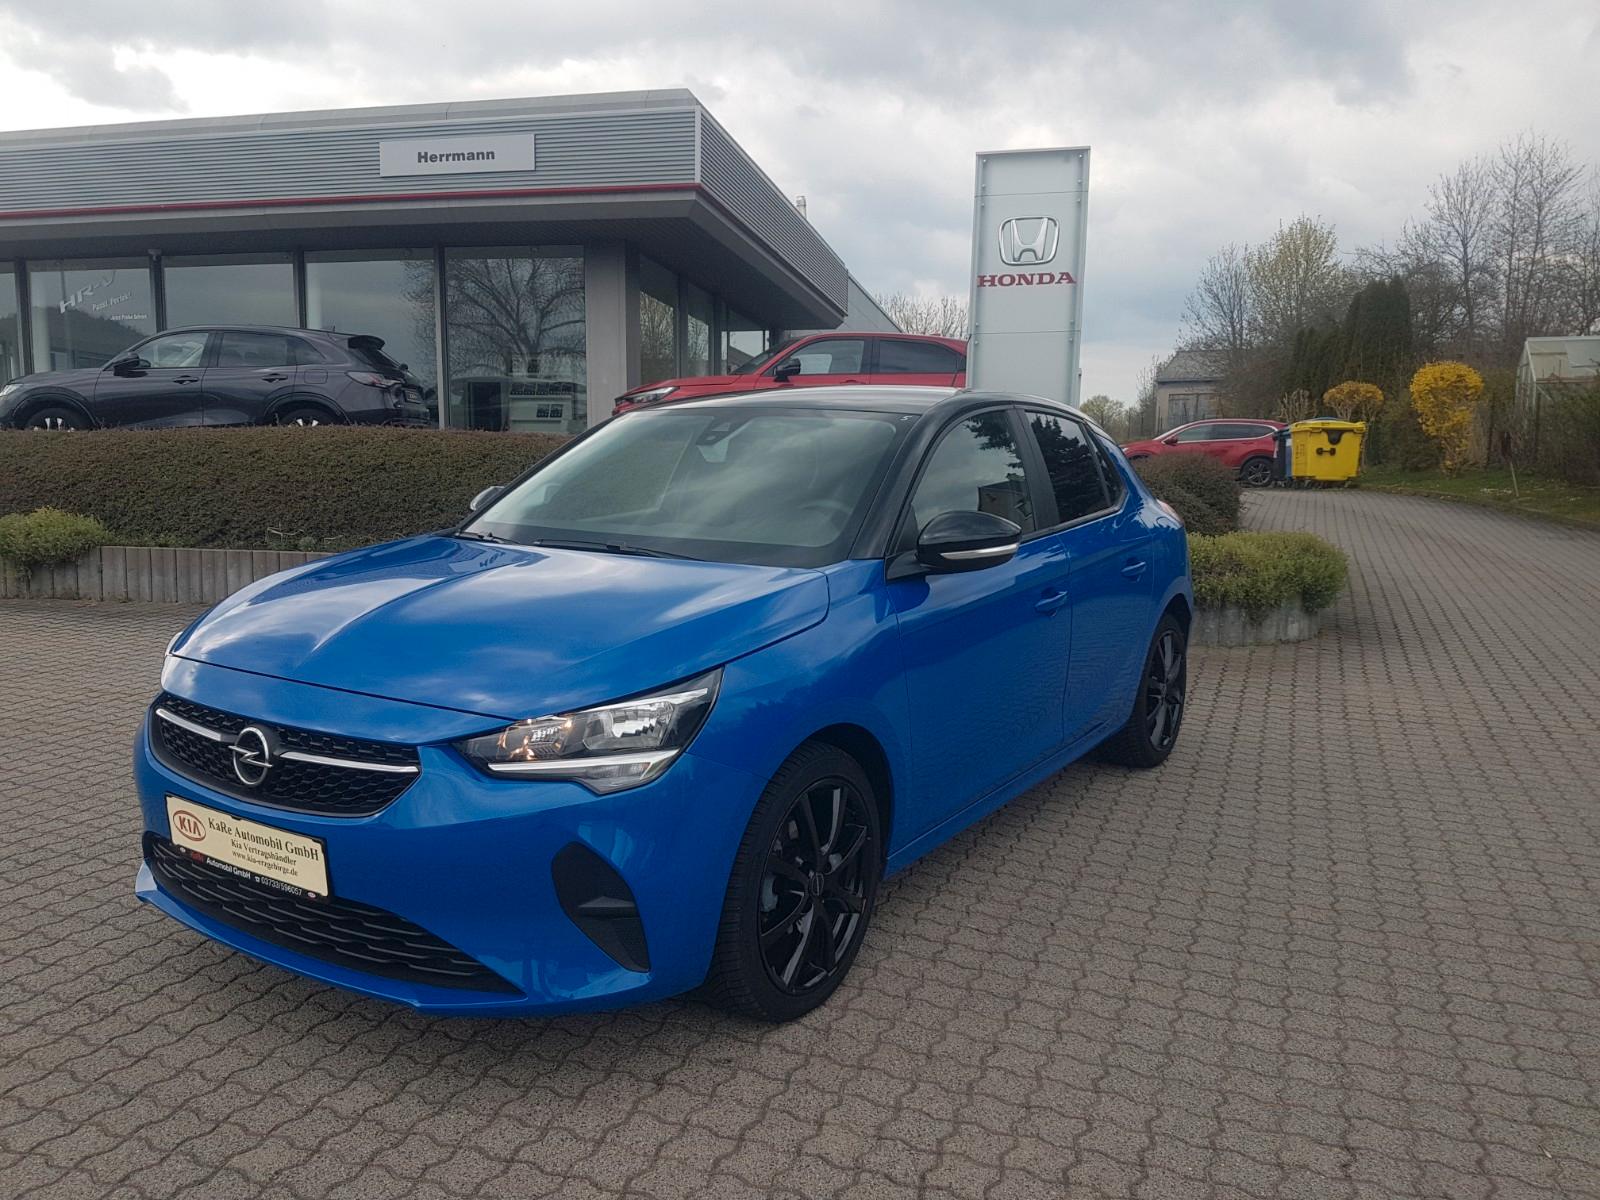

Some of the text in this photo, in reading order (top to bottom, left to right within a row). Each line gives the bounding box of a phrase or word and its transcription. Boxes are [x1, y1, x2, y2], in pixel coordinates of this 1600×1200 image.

[417, 150, 496, 163] Herrmann
[976, 272, 1077, 288] HONDA
[178, 815, 202, 838] KIA
[208, 817, 319, 861] KaRe Automobil GmbH
[231, 838, 242, 849] Kia
[206, 857, 233, 872] Automobil
[232, 867, 251, 879] GmbH
